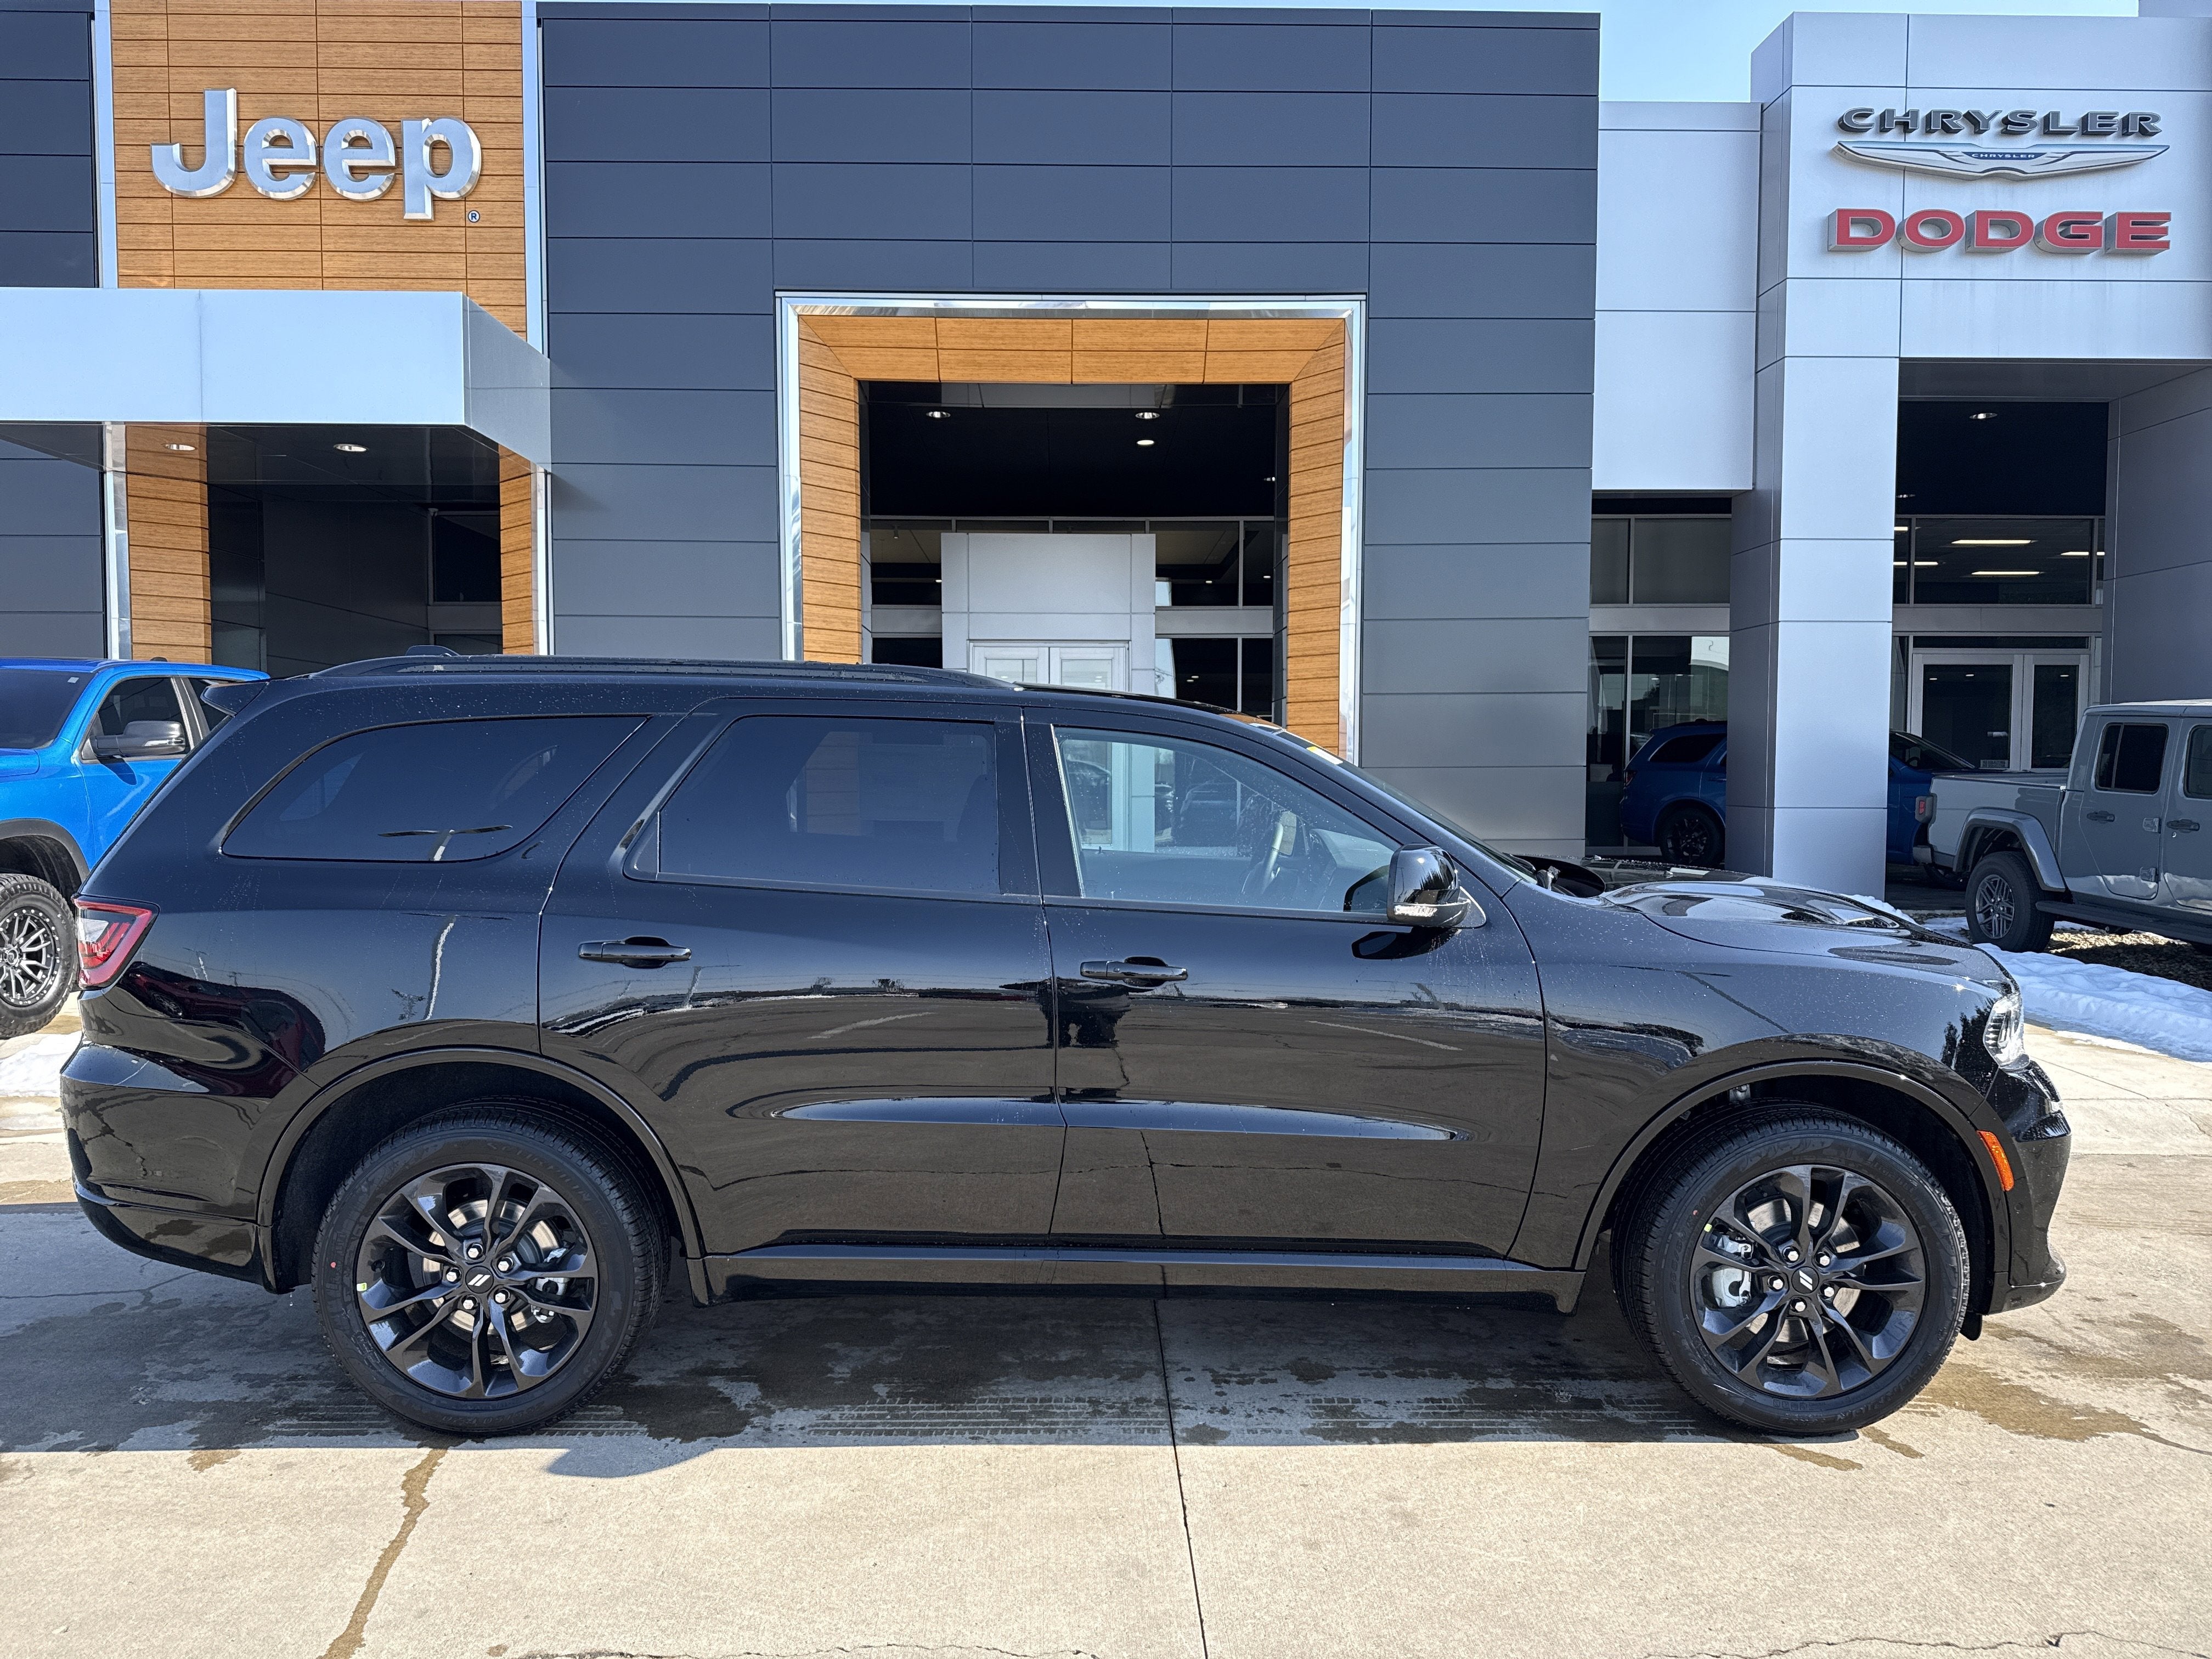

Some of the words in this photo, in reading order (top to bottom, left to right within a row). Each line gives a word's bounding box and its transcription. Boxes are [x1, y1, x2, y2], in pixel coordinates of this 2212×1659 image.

[1837, 108, 2162, 136] CHRYSLER
[150, 88, 482, 221] Jeep
[1827, 208, 2172, 254] DODGE
